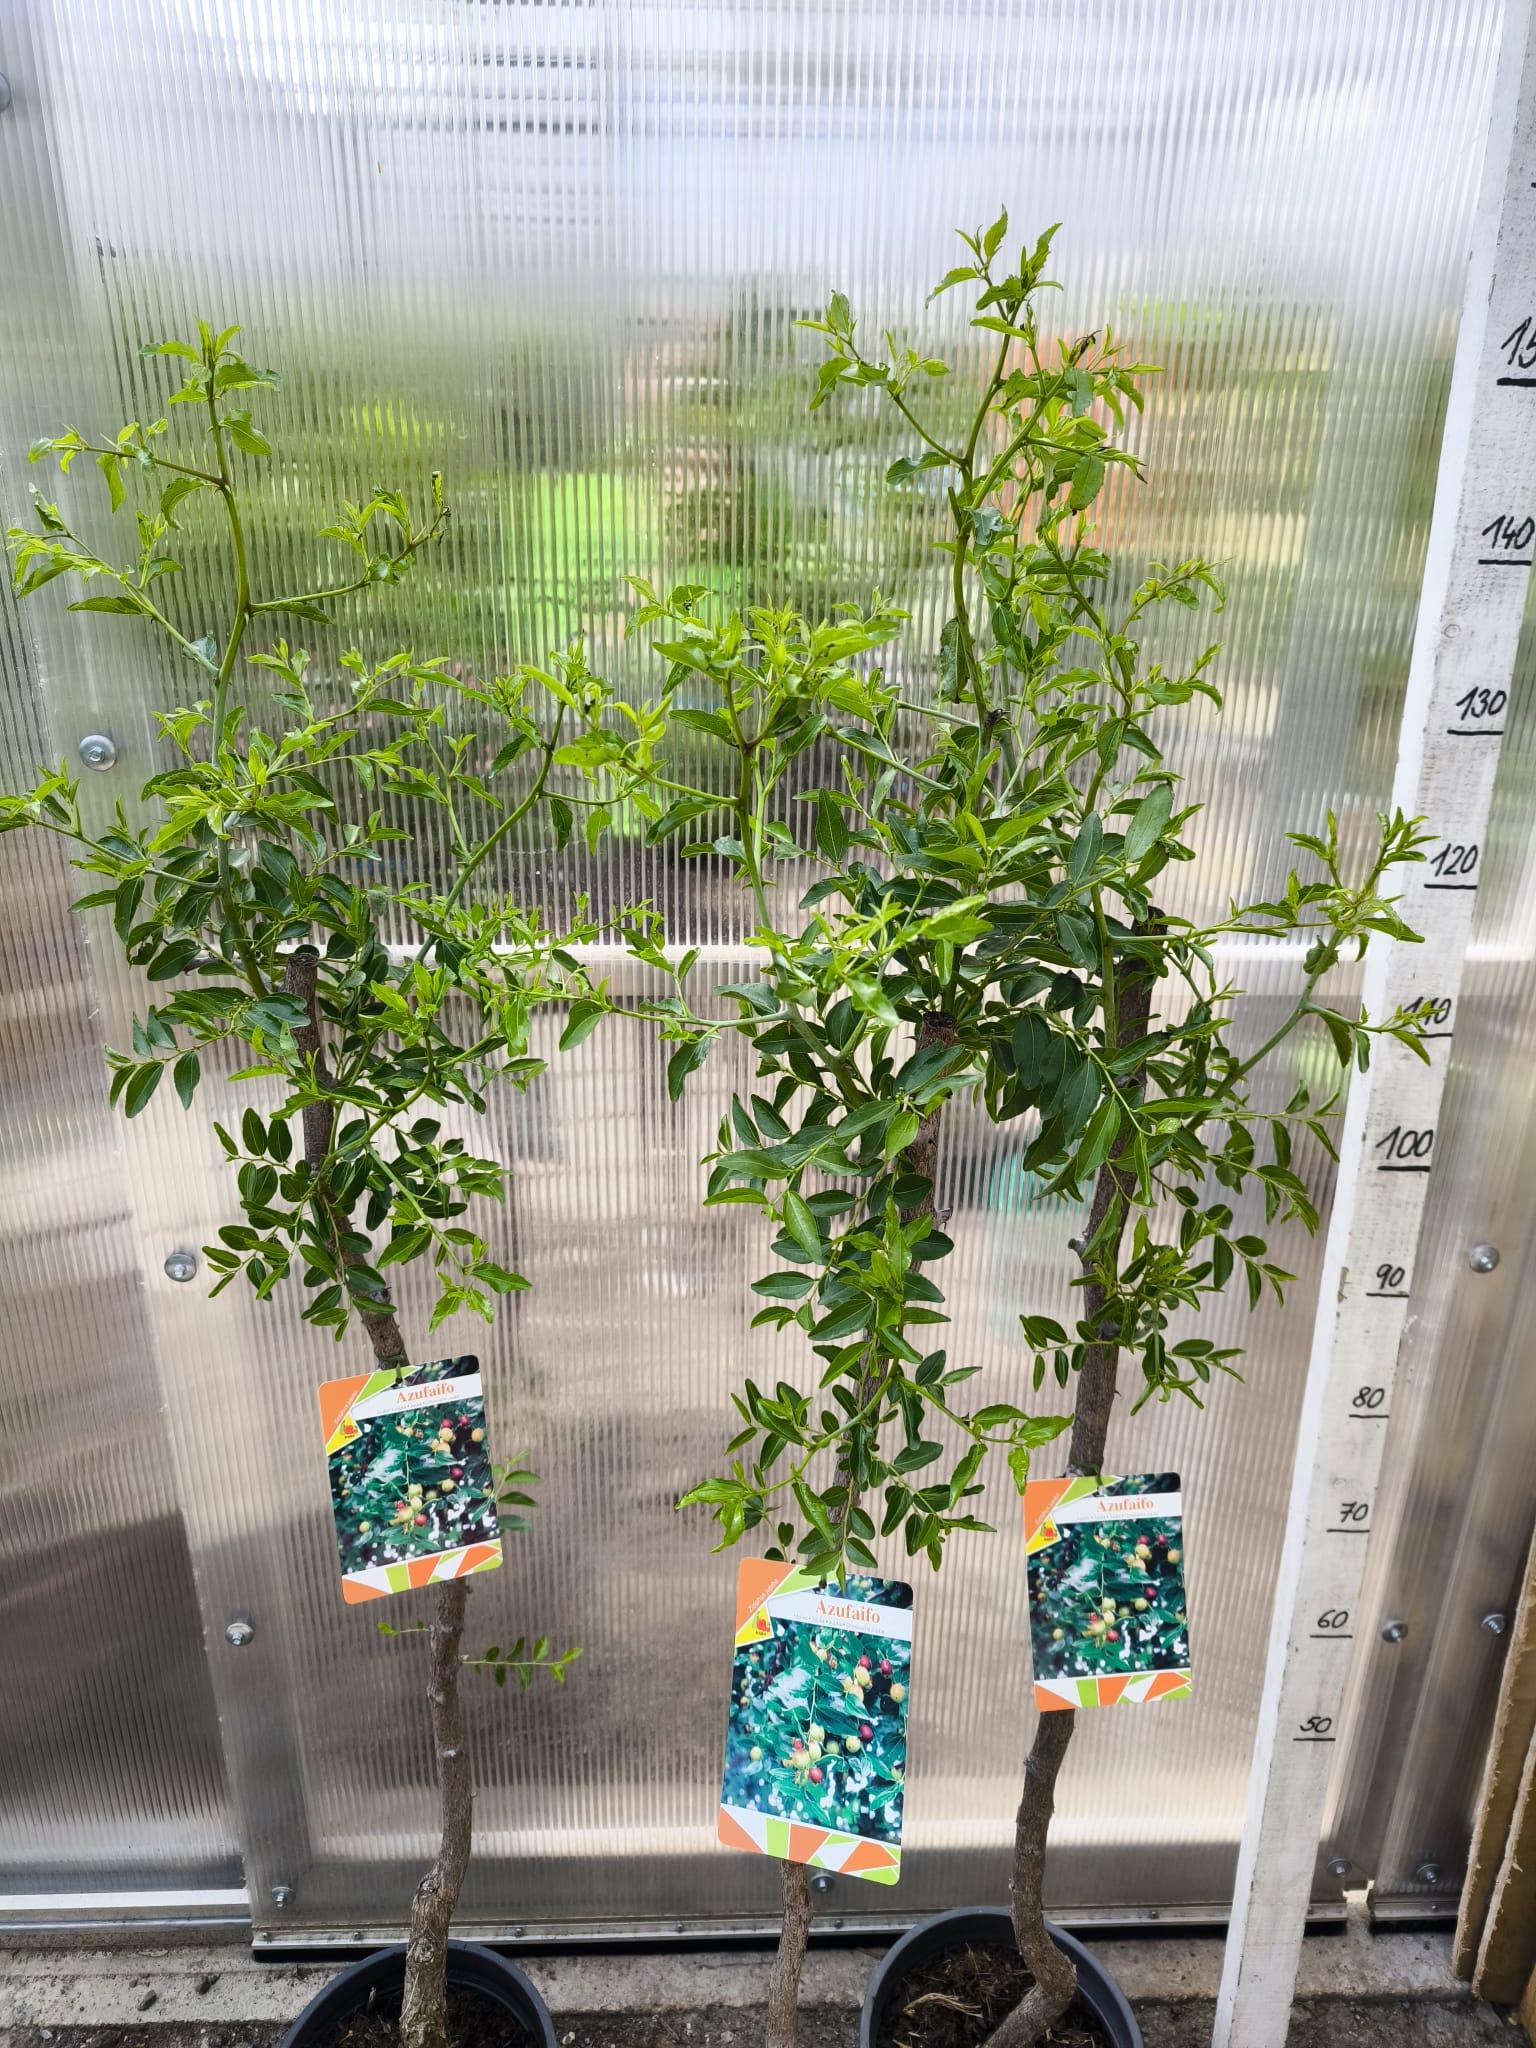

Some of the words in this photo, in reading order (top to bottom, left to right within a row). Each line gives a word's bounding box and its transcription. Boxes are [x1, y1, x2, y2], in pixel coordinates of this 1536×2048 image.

[1482, 514, 1535, 550] 140
[1456, 686, 1507, 721] 130
[1430, 844, 1479, 877] 120
[1375, 1125, 1434, 1160] 100
[1376, 1263, 1406, 1288] 90
[396, 1383, 455, 1404] Azufaifo
[1352, 1386, 1385, 1410] 80
[1097, 1497, 1154, 1513] Azufaifo
[1339, 1502, 1369, 1523] 70
[816, 1598, 881, 1624] Azufaifo
[1317, 1609, 1349, 1629] 60
[1299, 1716, 1332, 1733] 50
